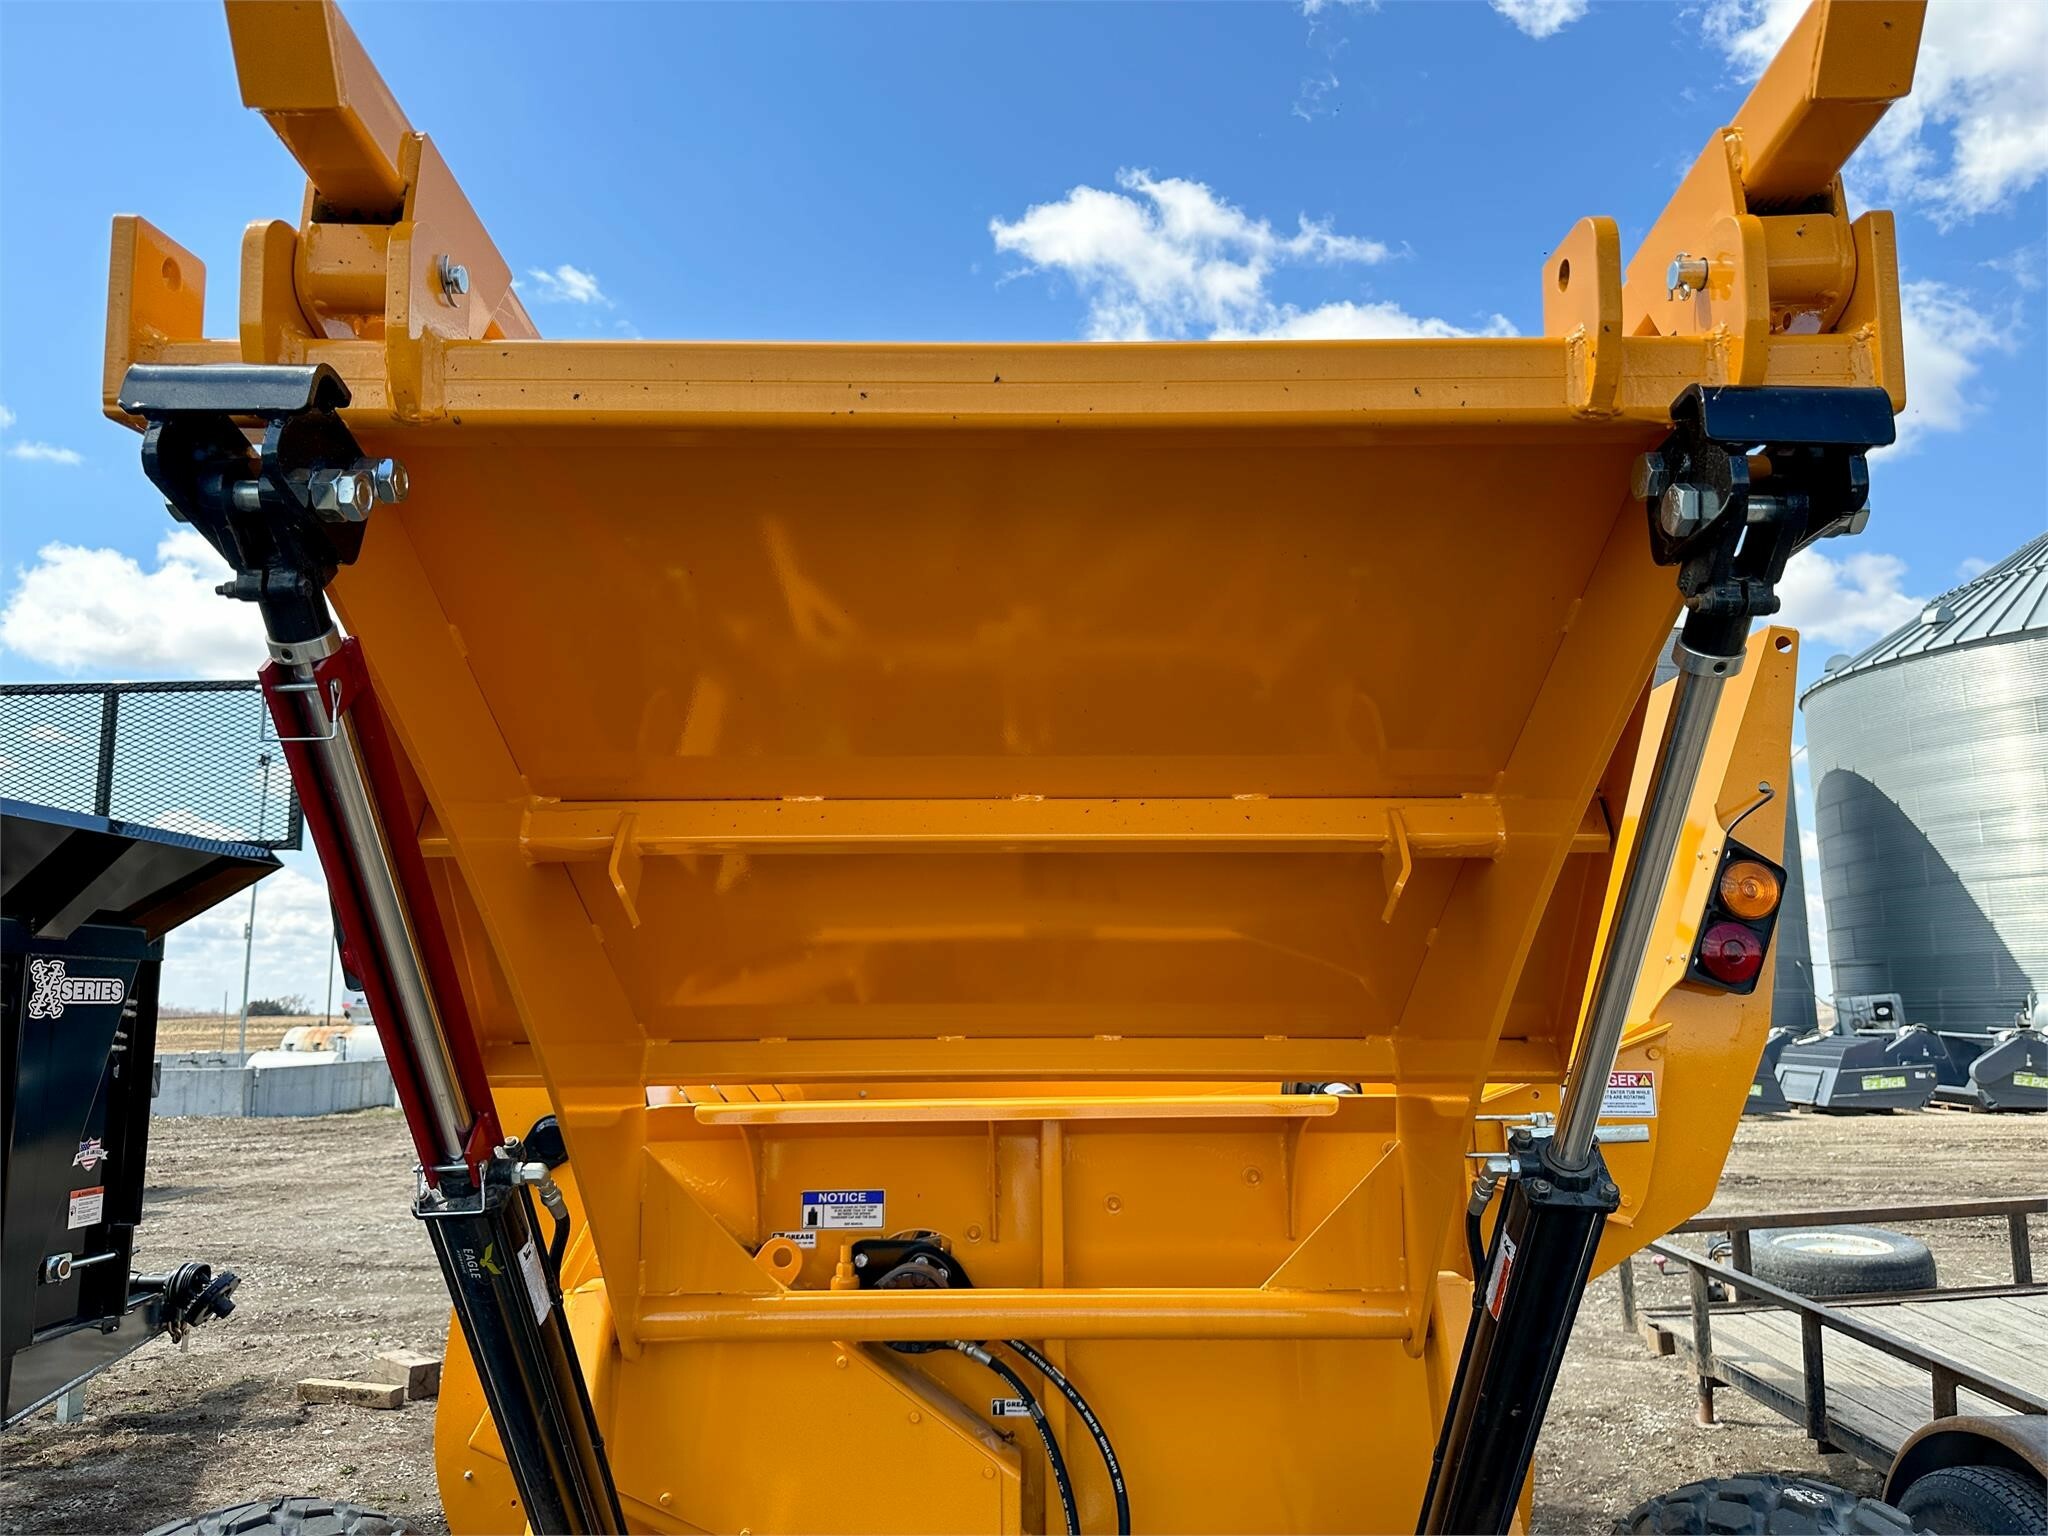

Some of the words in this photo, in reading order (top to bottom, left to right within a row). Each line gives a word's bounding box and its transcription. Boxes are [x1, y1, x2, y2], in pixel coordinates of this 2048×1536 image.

[60, 980, 122, 1001] SERIES
[1608, 1074, 1638, 1086] GER
[818, 1192, 867, 1203] NOTICE
[463, 1248, 482, 1279] EAGLE
